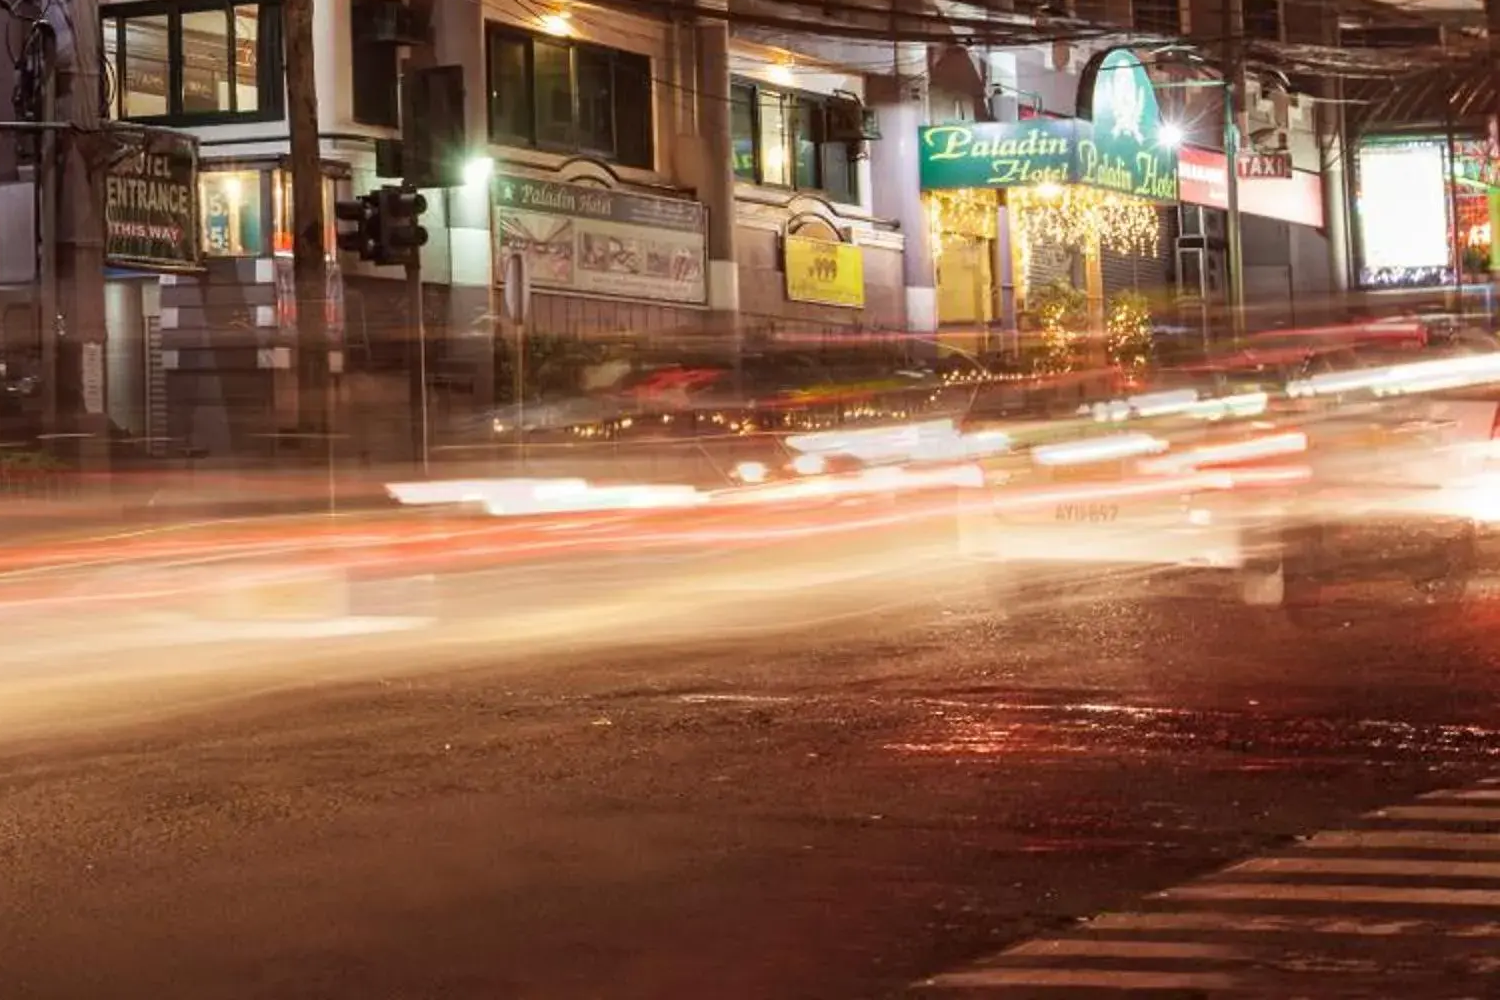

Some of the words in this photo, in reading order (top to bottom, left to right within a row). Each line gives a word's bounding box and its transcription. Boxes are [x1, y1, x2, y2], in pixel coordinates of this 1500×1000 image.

[923, 125, 1069, 161] Paladin
[132, 151, 172, 178] OTEL
[987, 159, 1069, 183] Hotel
[1079, 139, 1133, 192] Paladin
[1135, 150, 1178, 200] Hotel
[1237, 155, 1284, 177] TAXI
[106, 176, 189, 215] ENTRANCE
[521, 183, 576, 212] Paladin
[112, 221, 145, 237] THIS
[149, 225, 179, 241] WAY
